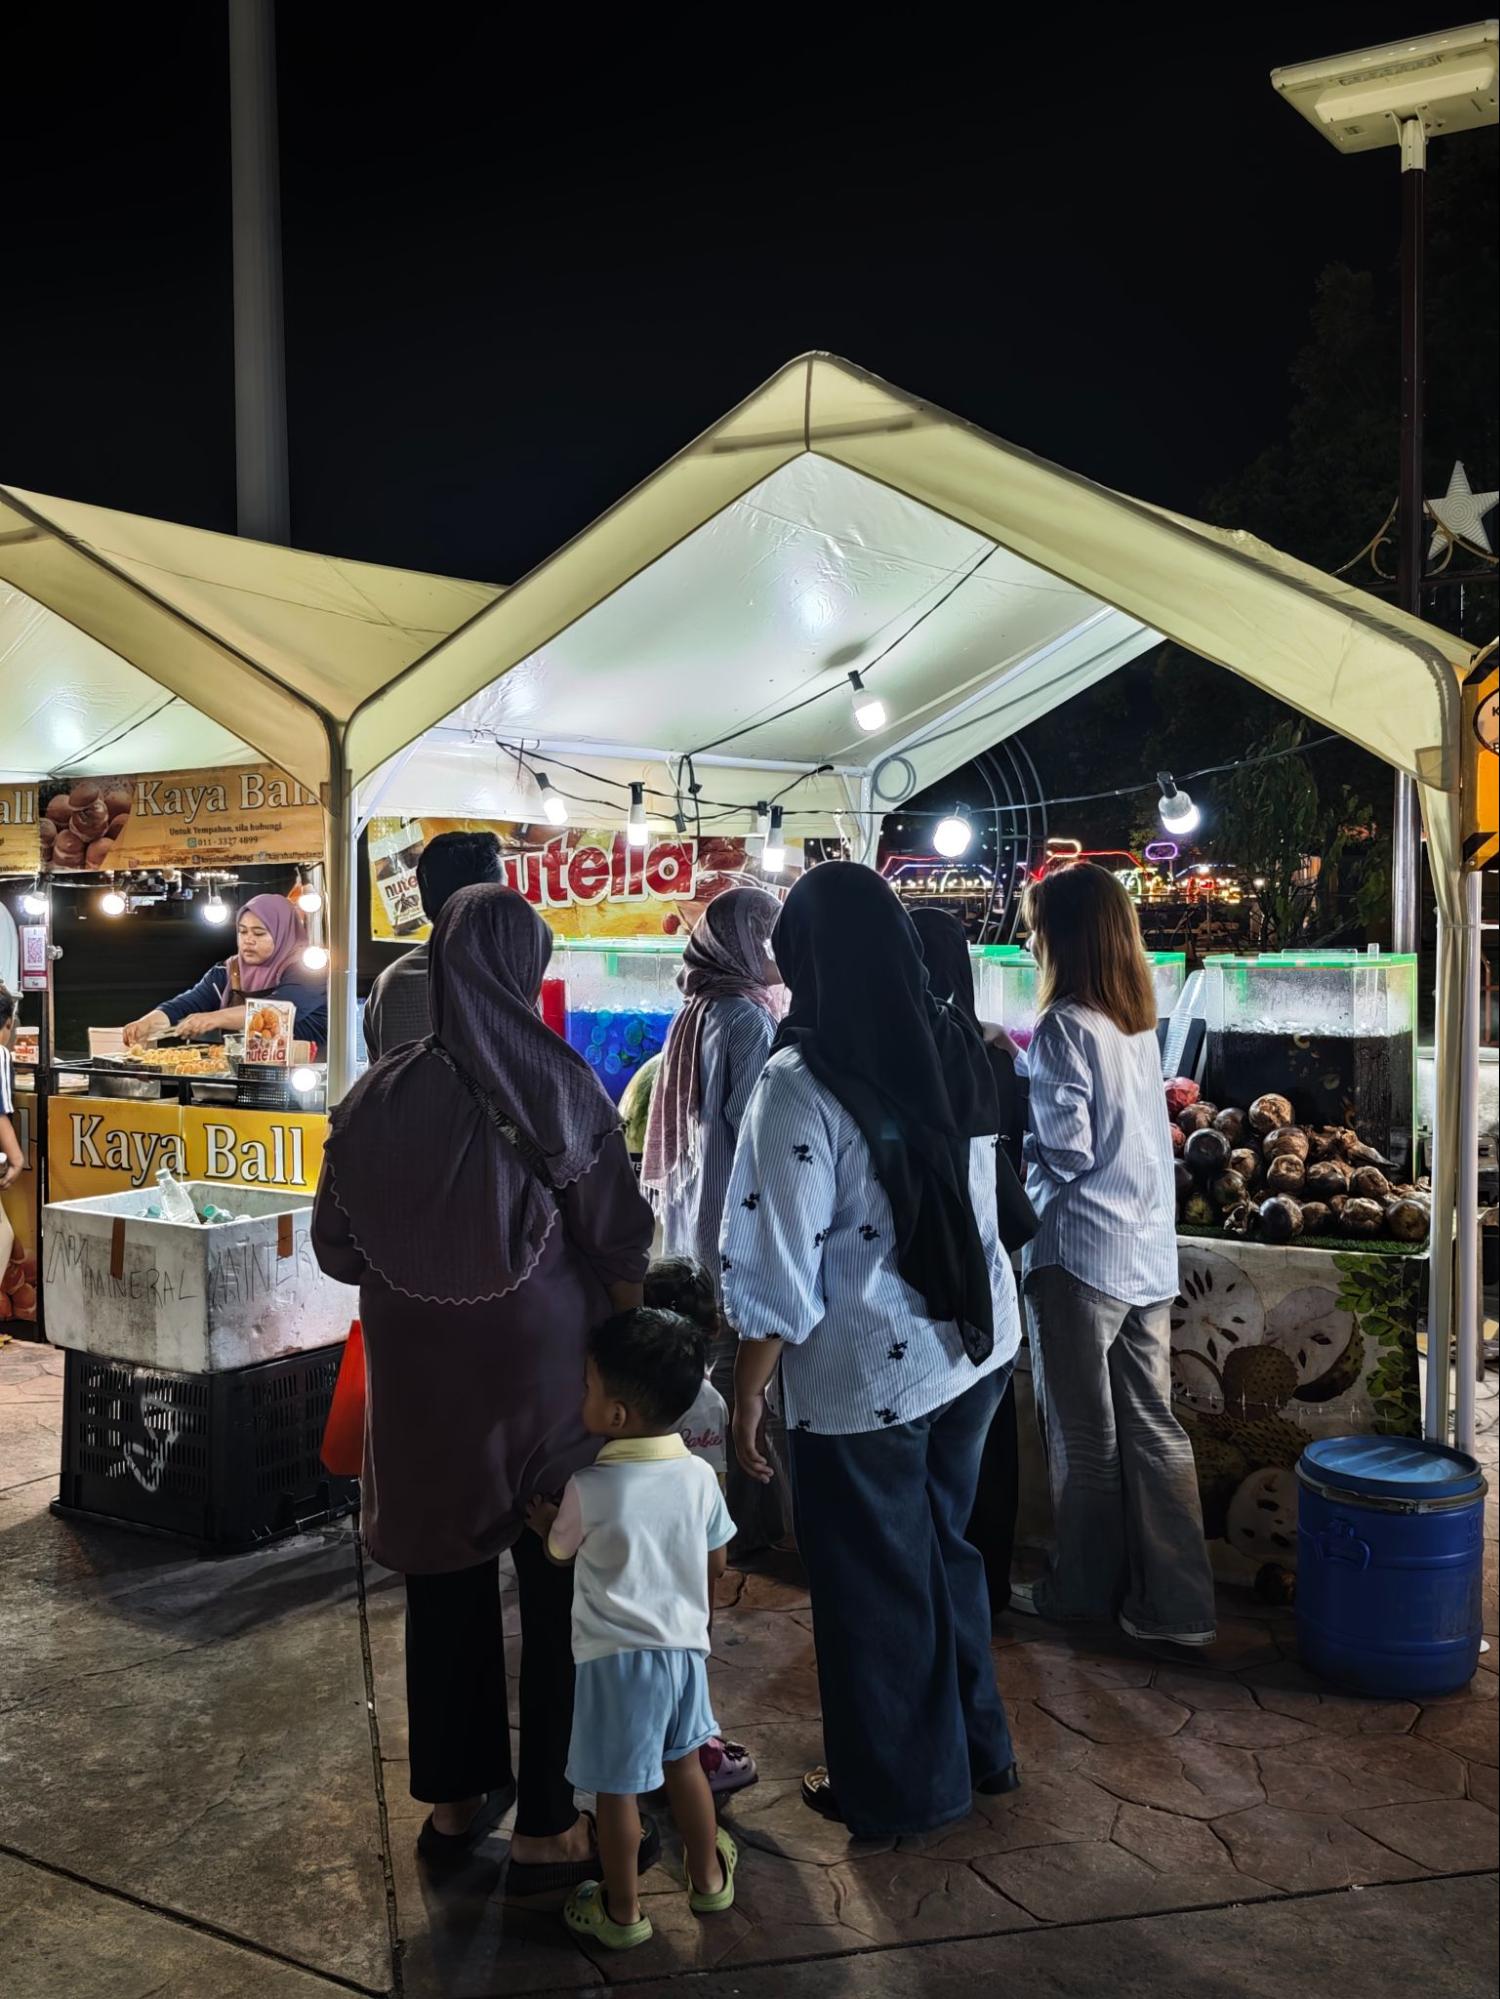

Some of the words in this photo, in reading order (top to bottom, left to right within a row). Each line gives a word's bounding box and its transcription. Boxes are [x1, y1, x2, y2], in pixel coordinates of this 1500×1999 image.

[136, 779, 228, 824] Kaya
[239, 772, 319, 810] Bal
[169, 827, 191, 836] Untuk
[193, 825, 233, 835] Tempahan,
[235, 823, 248, 832] sila
[250, 822, 282, 832] hubungi
[502, 831, 696, 906] utella
[70, 1113, 190, 1187] Kaya
[203, 1122, 306, 1186] Ball
[84, 1264, 198, 1309] MINERAL
[681, 1428, 723, 1448] Barbie
